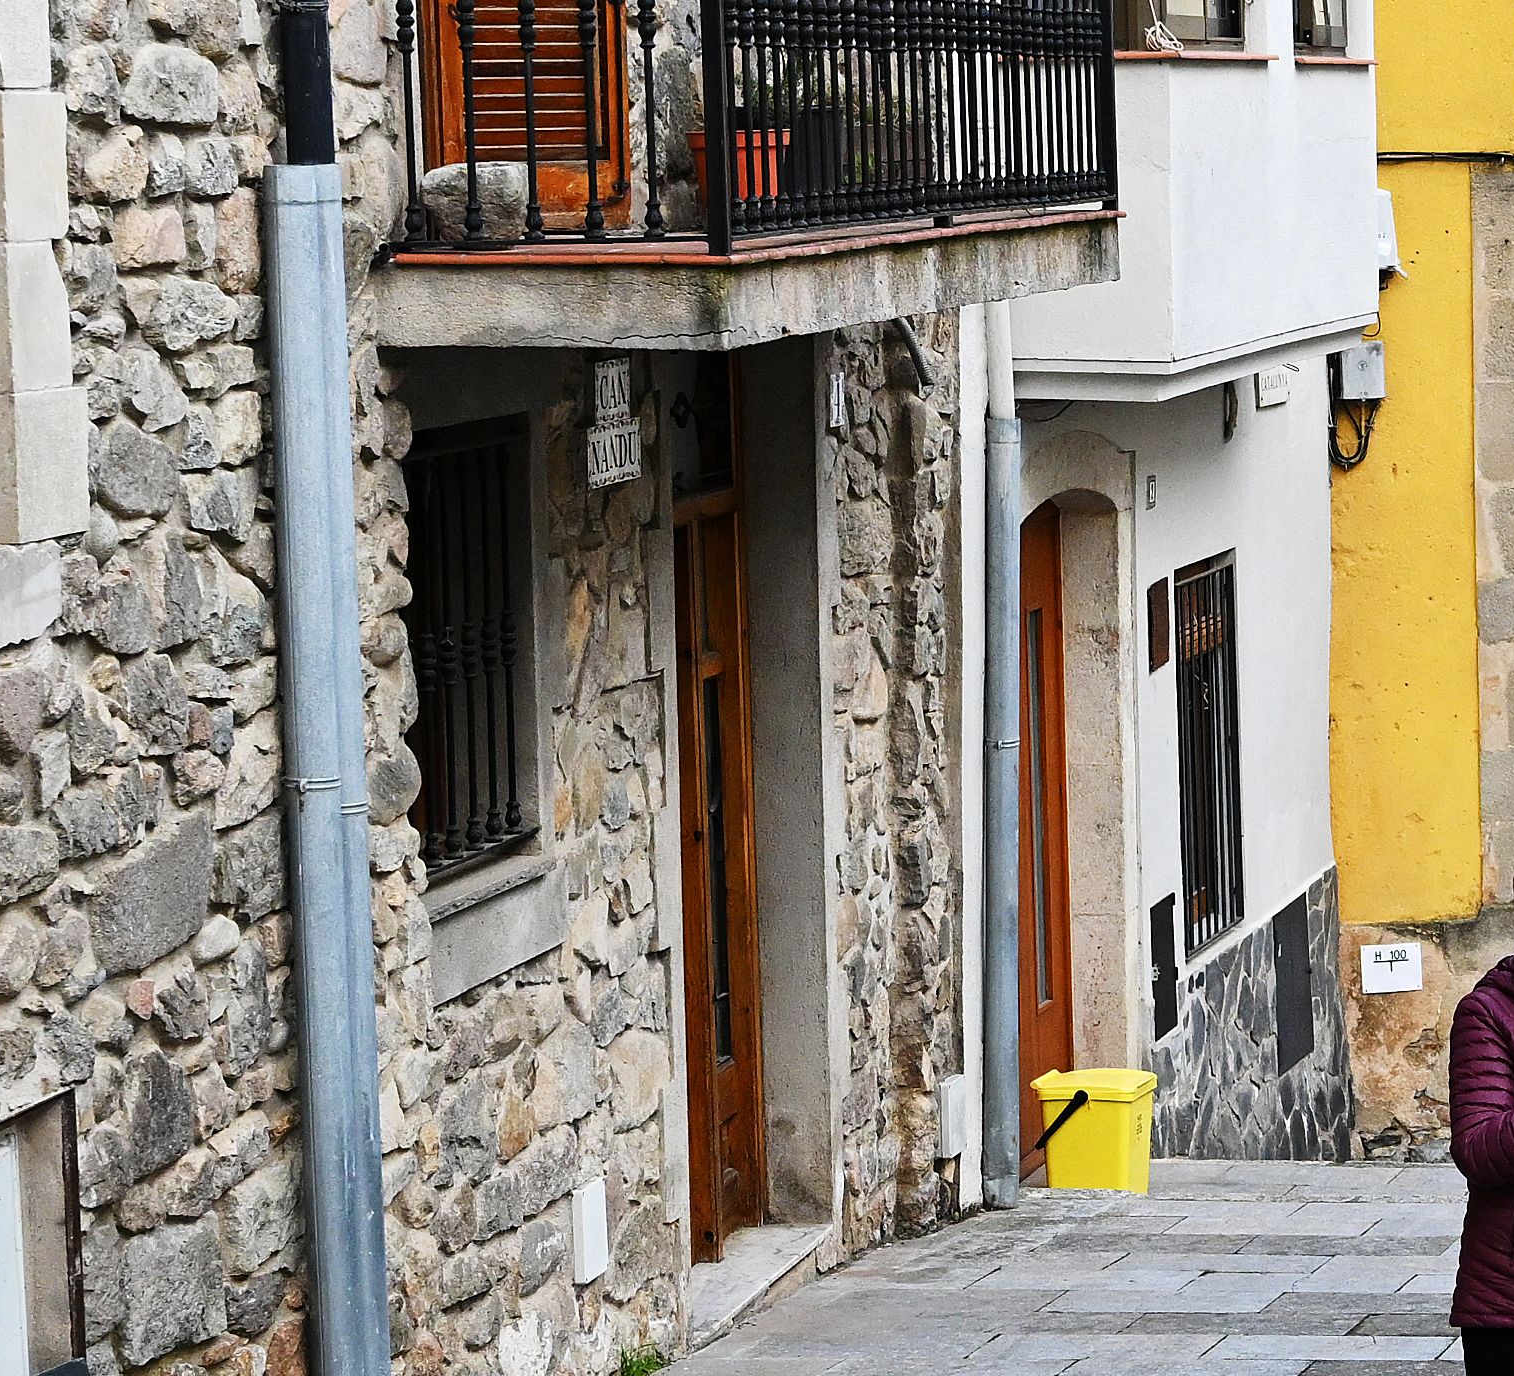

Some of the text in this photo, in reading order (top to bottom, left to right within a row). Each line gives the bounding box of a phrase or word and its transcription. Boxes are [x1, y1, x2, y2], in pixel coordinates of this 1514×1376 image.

[599, 371, 627, 410] CAN
[591, 431, 637, 476] NANDU
[1374, 949, 1407, 960] H 100
